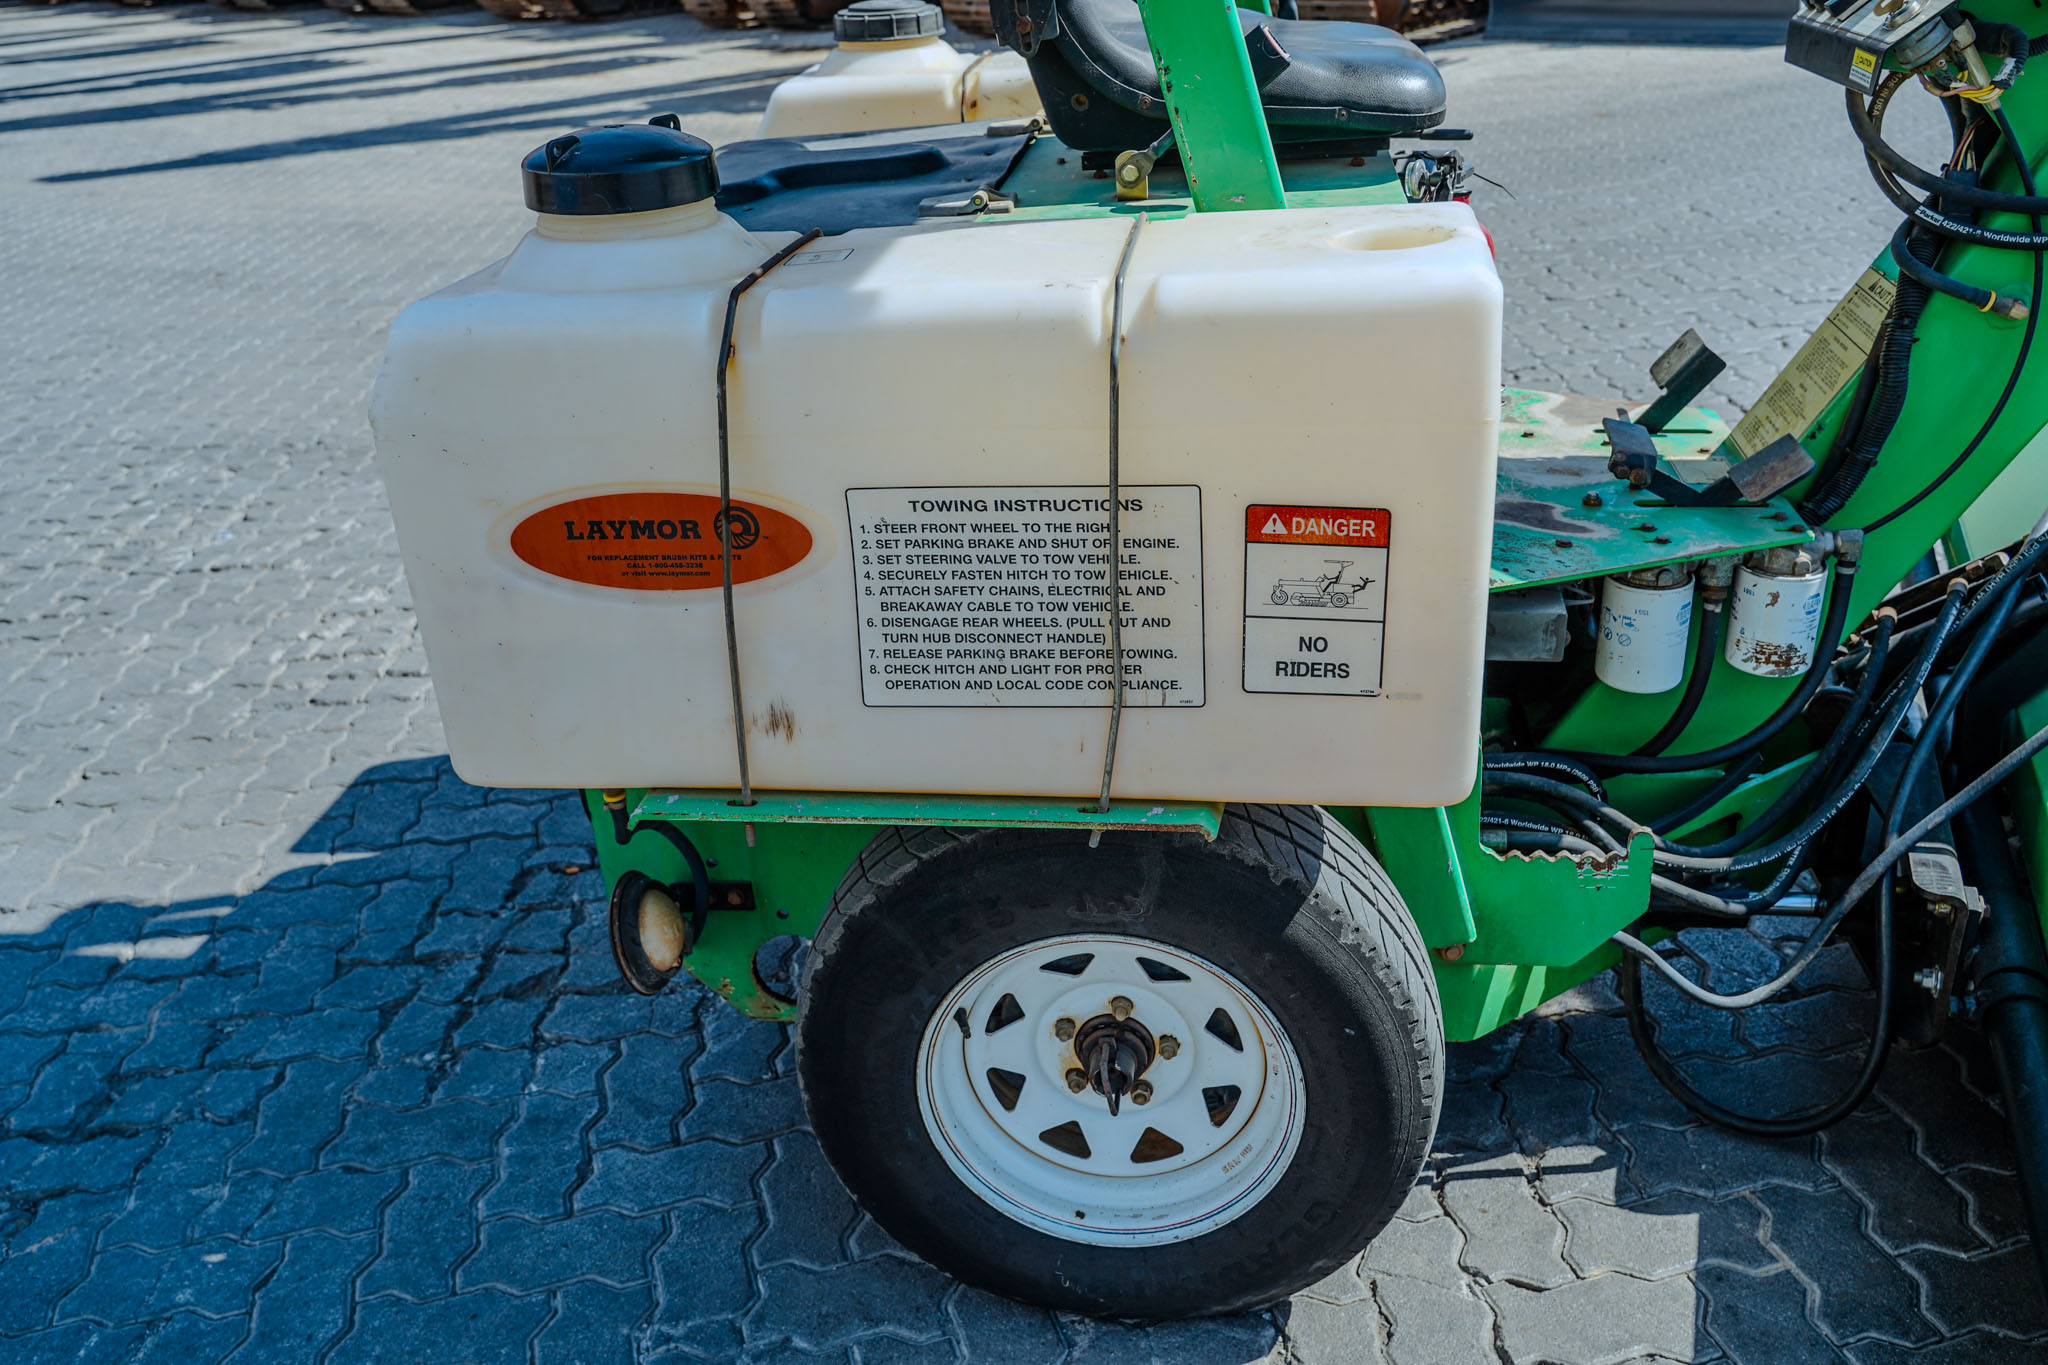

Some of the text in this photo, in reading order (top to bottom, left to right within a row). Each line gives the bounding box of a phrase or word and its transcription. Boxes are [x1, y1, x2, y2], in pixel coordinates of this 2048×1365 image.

[1920, 208, 1941, 224] Parker
[1983, 231, 2031, 243] Worldwide
[1874, 285, 1895, 306] CAUTI
[907, 498, 1144, 513] TOWING INSTRUCTIONS
[564, 520, 702, 541] LAYMOR
[859, 522, 1121, 534] 1. STEER FRONT WHEEL TO THE RIGH.
[1292, 517, 1376, 538] DANGER
[860, 538, 1180, 549] 2. SET PARKING BRAKE AND SHUT OF ENGINE.
[862, 553, 1141, 565] 3. SET STEERING VALVE TO TOW VEHILE.
[863, 569, 1174, 581] 4. SECURELY FASTEN HITCH TO TOW EHICLE.
[864, 585, 876, 597] 5.
[878, 585, 931, 597] ATTACH
[933, 585, 985, 597] SAFETY
[988, 585, 1044, 599] CHAINS,
[1135, 585, 1166, 597] AND
[880, 601, 1135, 613] BREAKAWAY CABLE TO TOW VEHICE.
[866, 617, 878, 628] 6.
[881, 617, 959, 628] DISENGAGE
[962, 617, 999, 628] REAR
[1001, 617, 1063, 628] WHEELS.
[1066, 617, 1106, 630] (PULL
[1140, 617, 1172, 628] AND
[881, 632, 1107, 646] TURN HUB DISCONNECT HANDLE)
[1298, 636, 1329, 653] NO
[868, 648, 880, 660] 7.
[882, 648, 944, 660] RELEASE
[946, 648, 1006, 660] PARKING
[1009, 648, 1056, 660] BRAKE
[1059, 648, 1113, 660] BEFORE
[869, 664, 1143, 675] 8. CHECK HITCH AND LIGHT FOR PROER
[1275, 660, 1350, 679] RIDERS
[884, 679, 961, 691] OPERATION
[964, 679, 993, 691] AND
[996, 679, 1042, 691] LOCAL
[1044, 679, 1084, 691] CODE
[1486, 761, 1525, 769] Worldwide
[1510, 819, 1550, 832] Worldwide
